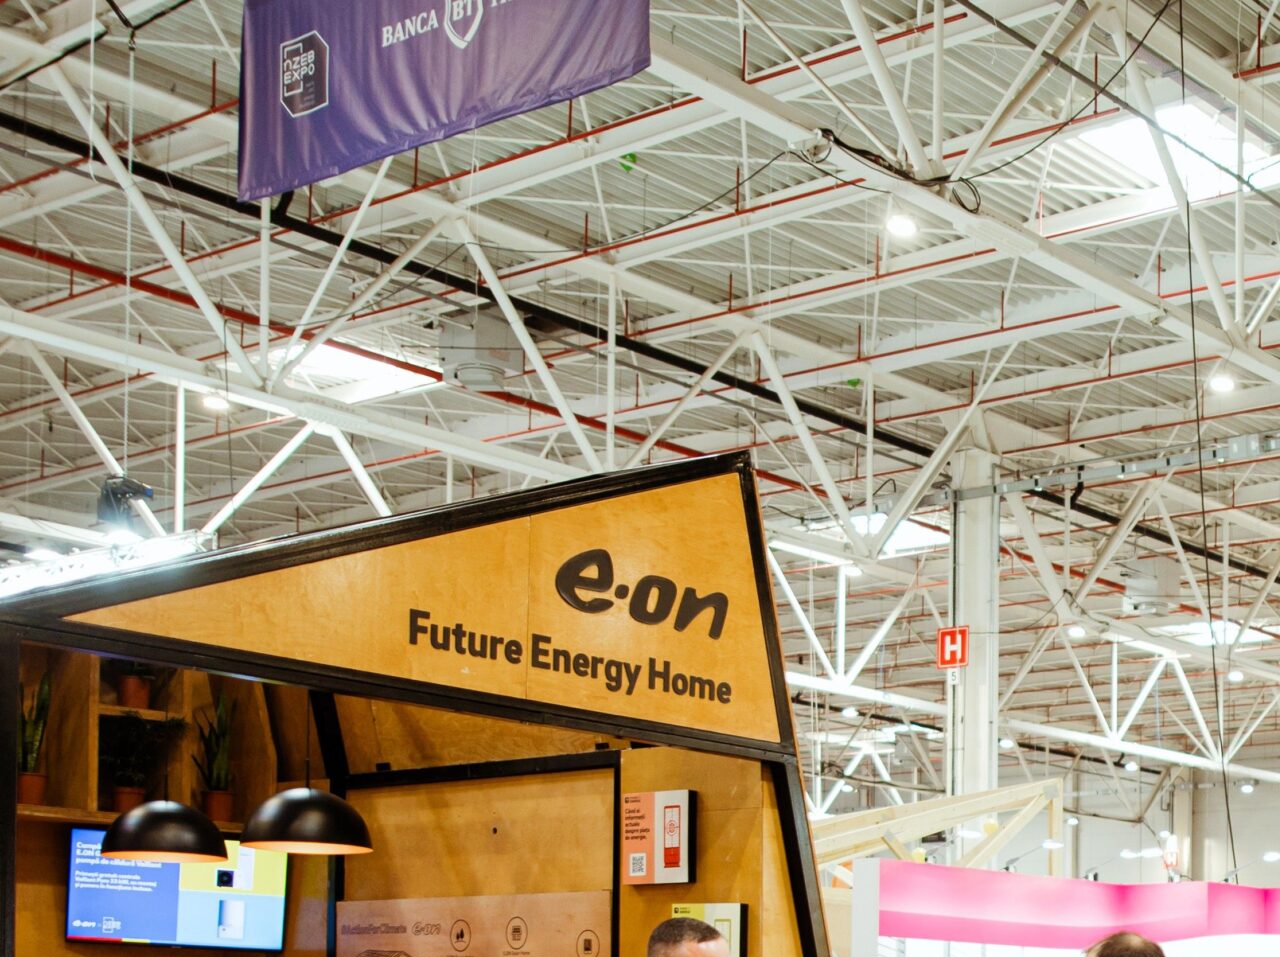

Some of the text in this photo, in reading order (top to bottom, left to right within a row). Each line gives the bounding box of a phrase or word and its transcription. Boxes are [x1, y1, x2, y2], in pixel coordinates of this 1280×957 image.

[382, 9, 439, 48] BANCA
[283, 64, 316, 84] EXPO
[408, 608, 732, 705] Future Energy Home
[944, 633, 962, 661] H
